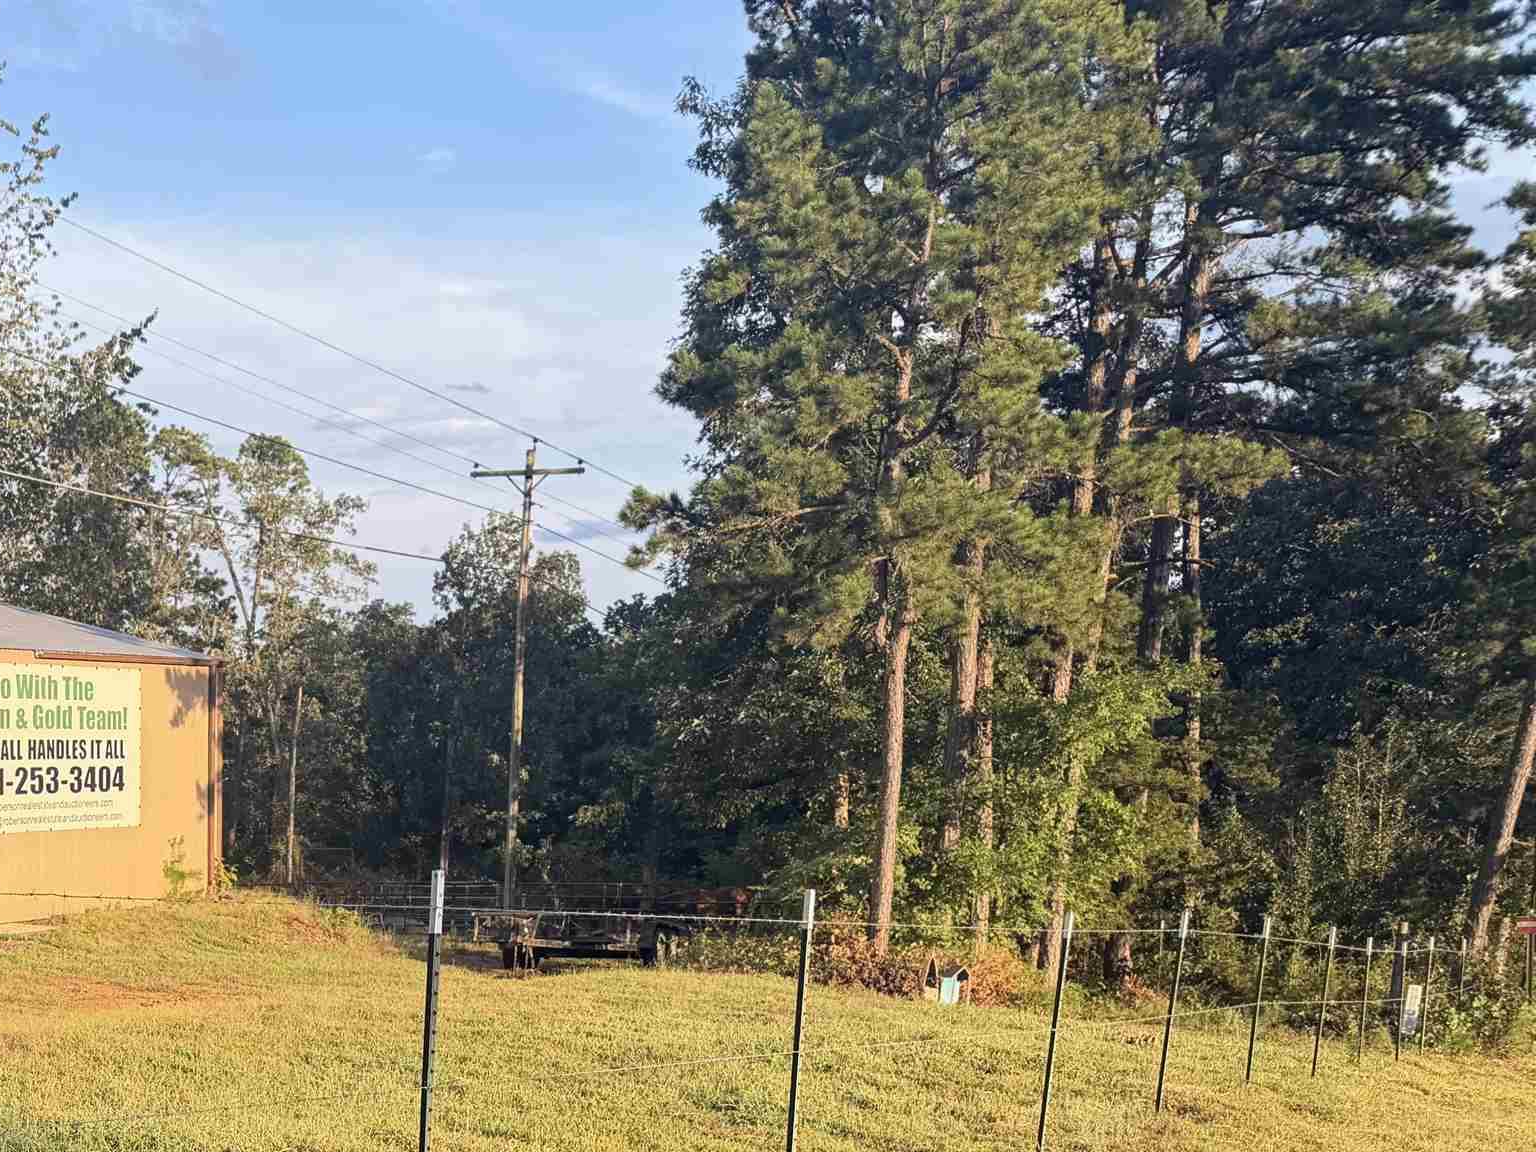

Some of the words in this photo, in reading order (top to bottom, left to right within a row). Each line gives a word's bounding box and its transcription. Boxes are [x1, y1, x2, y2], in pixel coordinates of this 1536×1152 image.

[15, 674, 58, 700] With
[62, 675, 94, 701] The
[16, 708, 28, 730] &
[32, 704, 73, 730] Gold
[77, 706, 128, 730] Team!
[28, 739, 87, 760] HANDLES
[90, 740, 101, 760] IT
[105, 740, 126, 760] ALL
